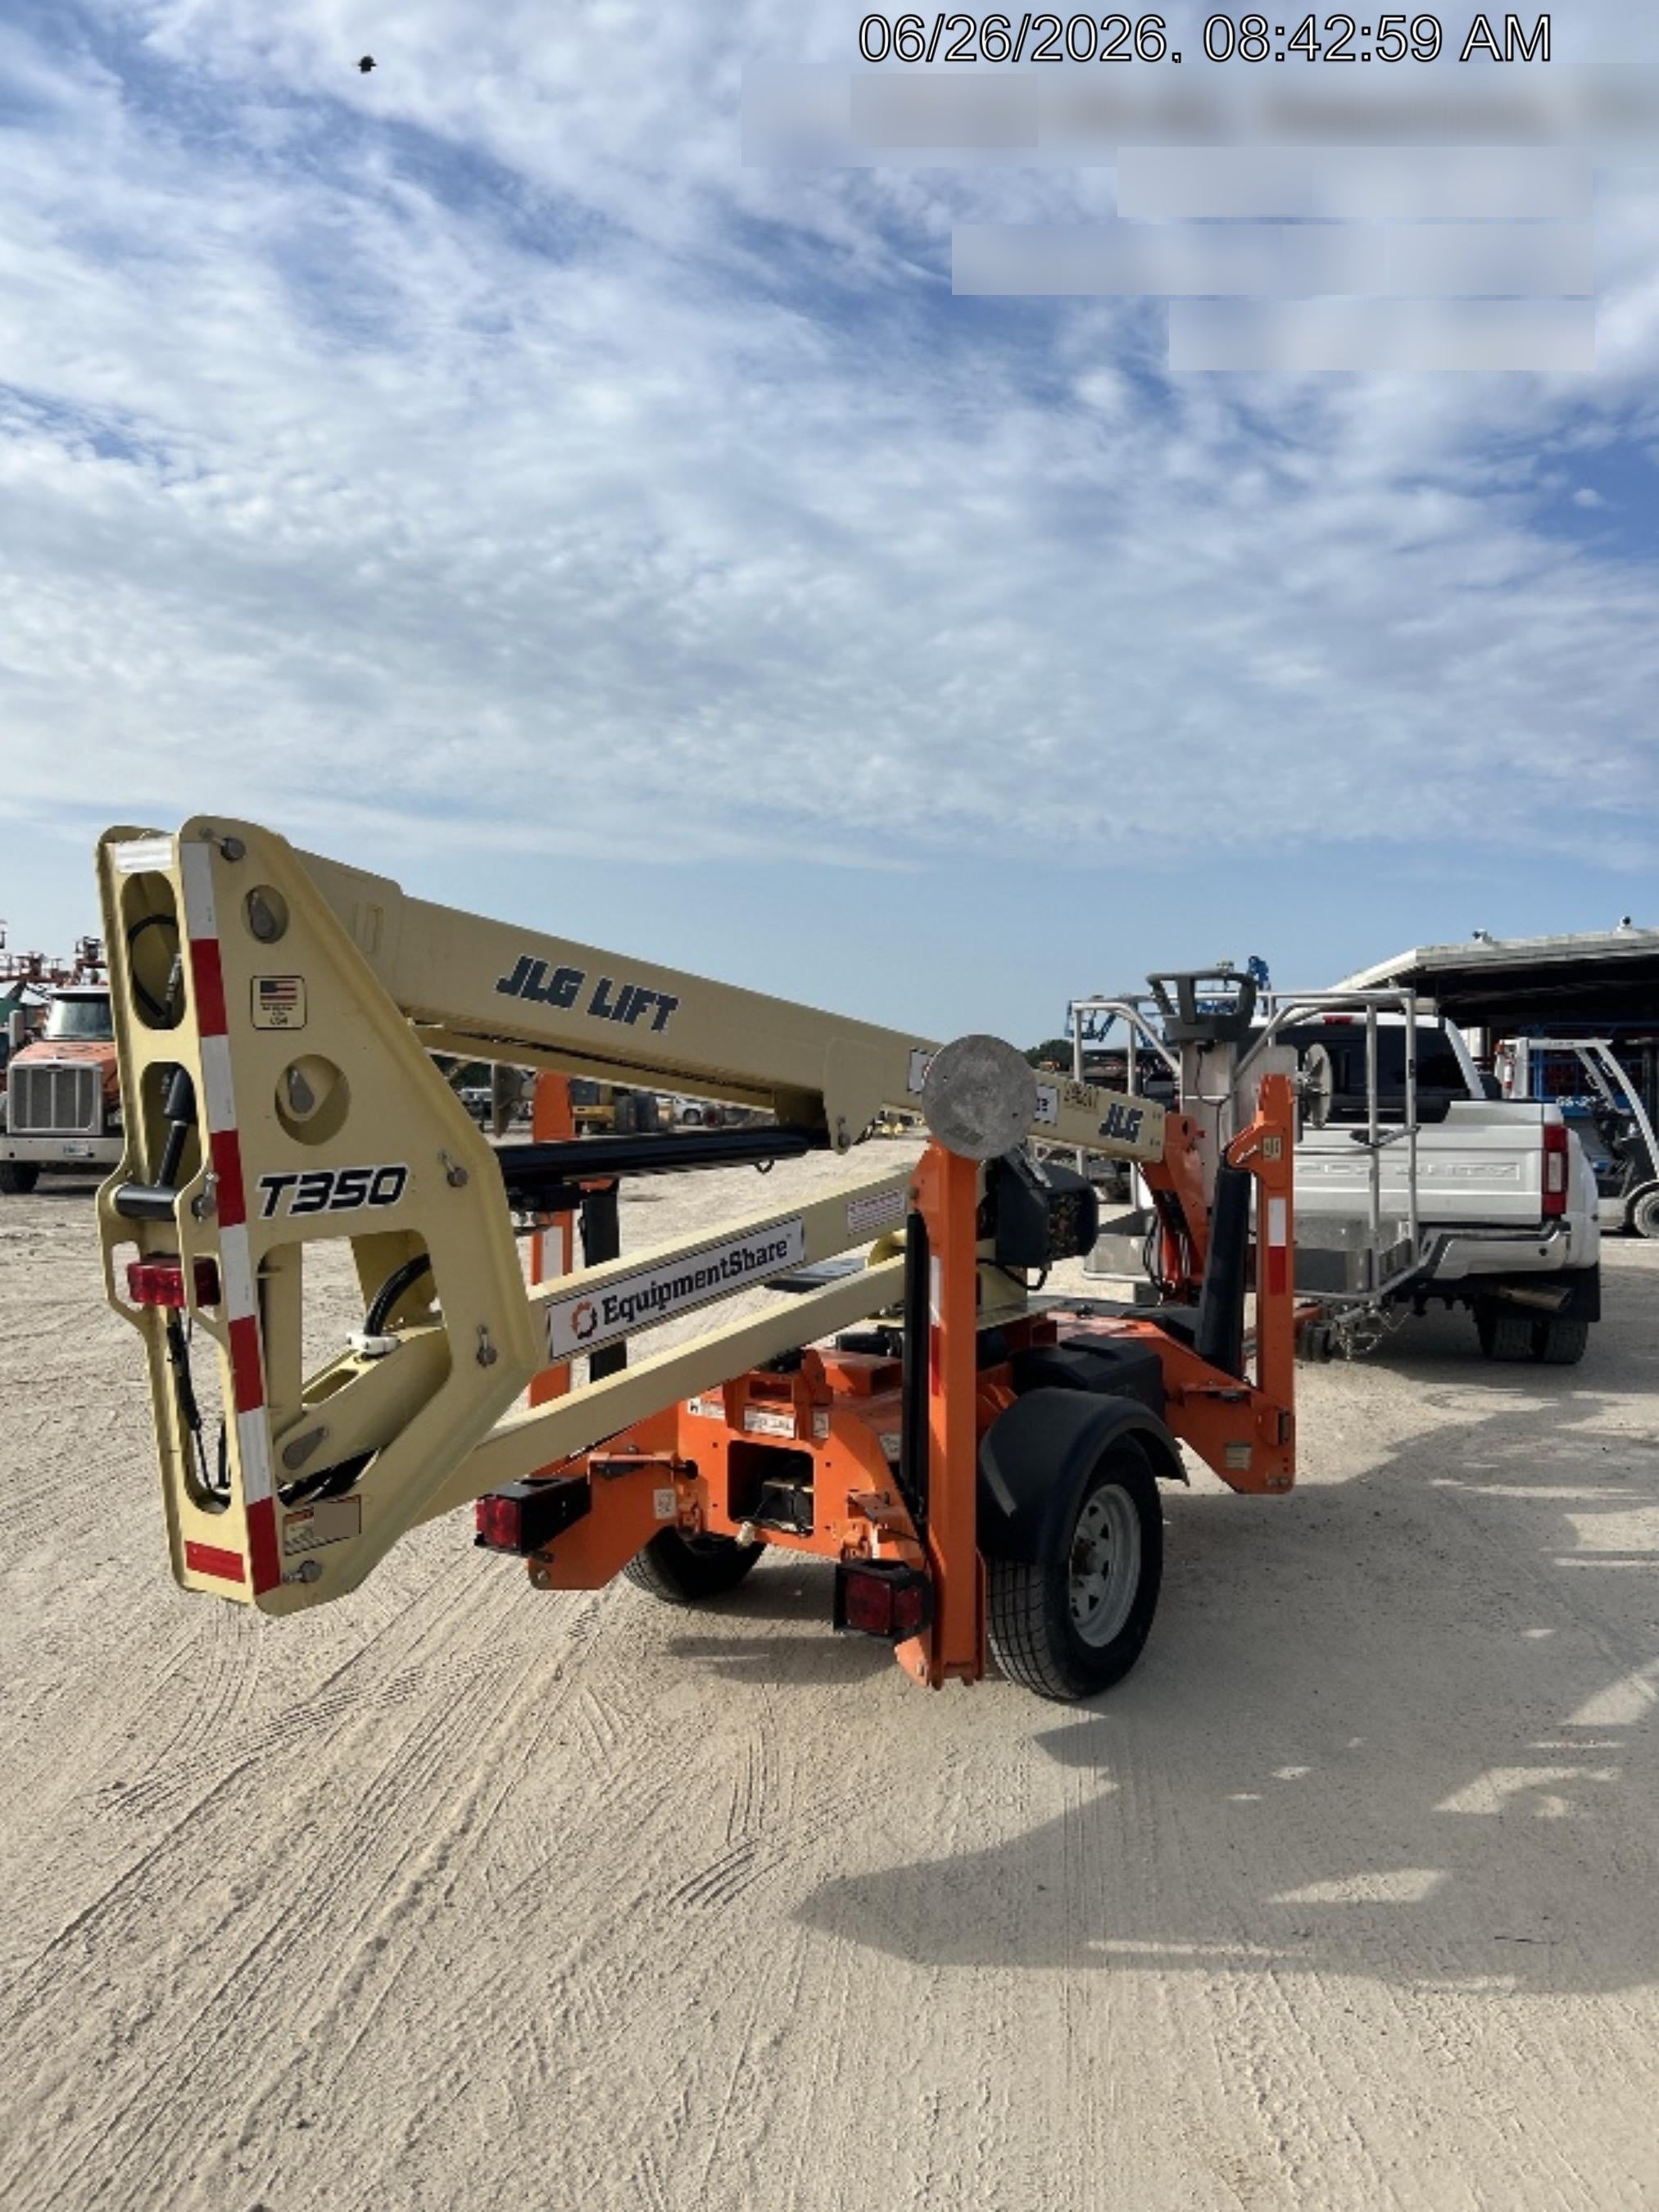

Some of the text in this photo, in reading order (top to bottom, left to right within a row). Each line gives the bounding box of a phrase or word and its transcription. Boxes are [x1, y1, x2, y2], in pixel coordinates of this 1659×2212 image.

[496, 955, 679, 1031] JLG LIFT
[1099, 1103, 1144, 1143] JLG
[259, 1166, 408, 1217] T350
[602, 1237, 787, 1326] EquipmentShare
